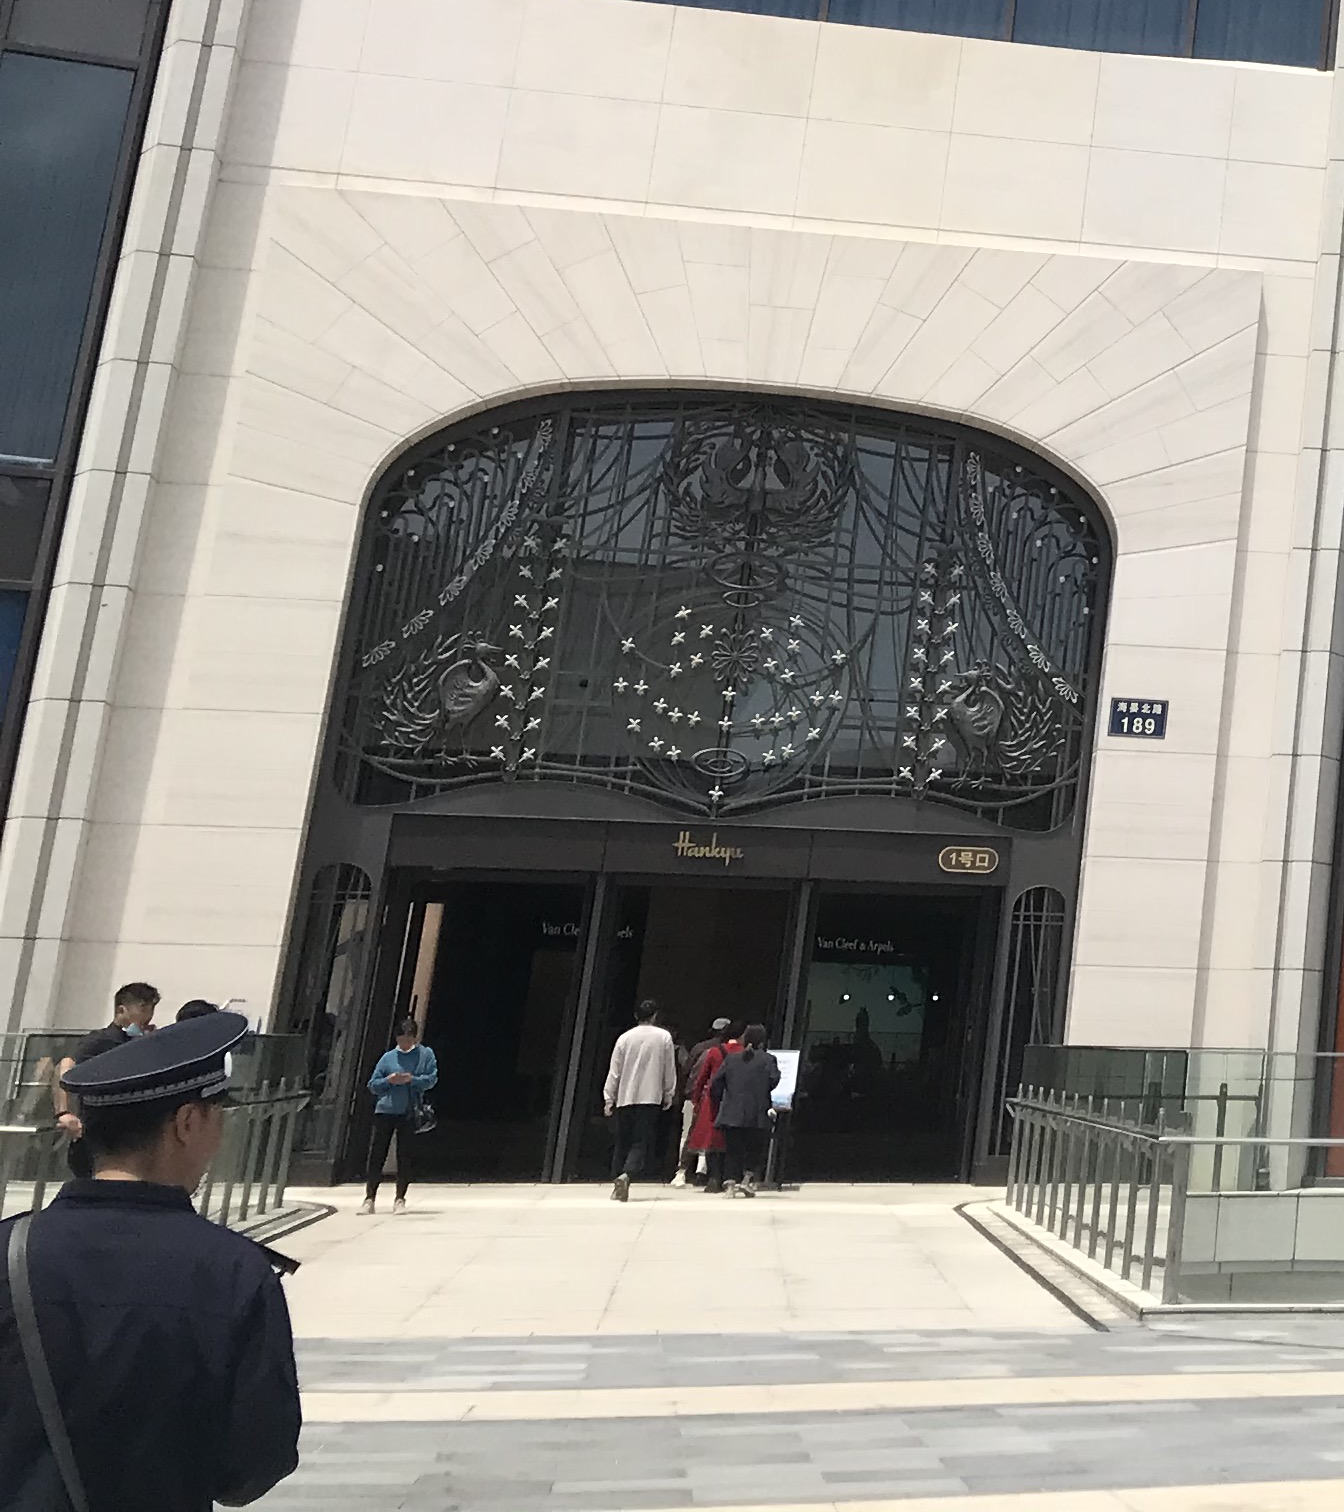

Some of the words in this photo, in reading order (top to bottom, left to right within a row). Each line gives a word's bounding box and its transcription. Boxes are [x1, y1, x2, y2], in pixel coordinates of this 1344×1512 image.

[1121, 716, 1156, 735] 189
[672, 830, 744, 867] Hankyu
[949, 851, 990, 868] 1号口
[542, 922, 561, 936] Van
[817, 936, 834, 949] Van
[835, 937, 859, 951] Cleef
[867, 940, 894, 956] Arpels
